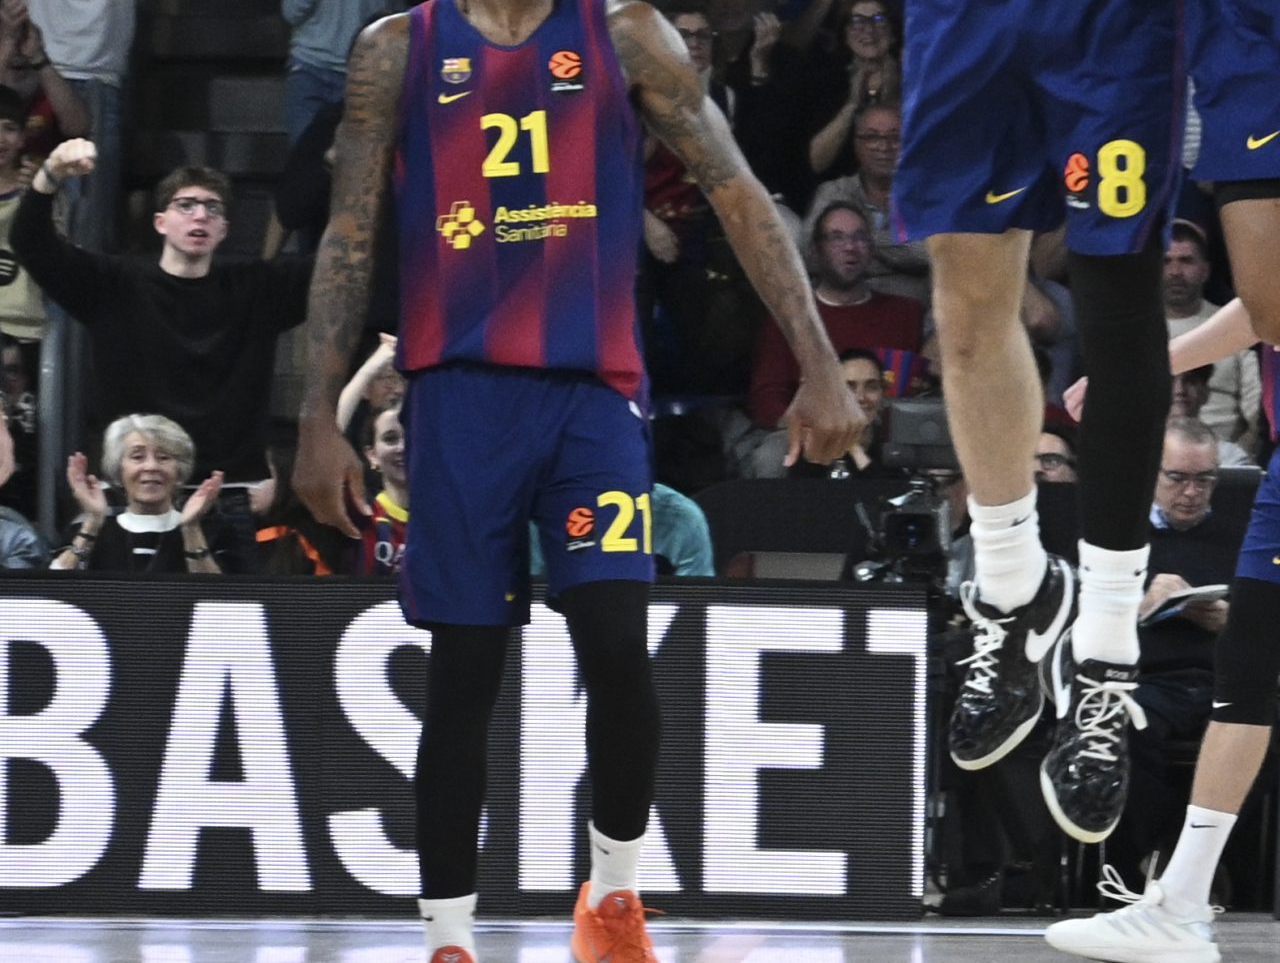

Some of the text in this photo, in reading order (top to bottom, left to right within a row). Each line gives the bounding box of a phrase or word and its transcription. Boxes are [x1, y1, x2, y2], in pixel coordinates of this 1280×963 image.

[480, 110, 550, 178] 21
[1097, 139, 1147, 218] 8
[597, 490, 652, 555] 21
